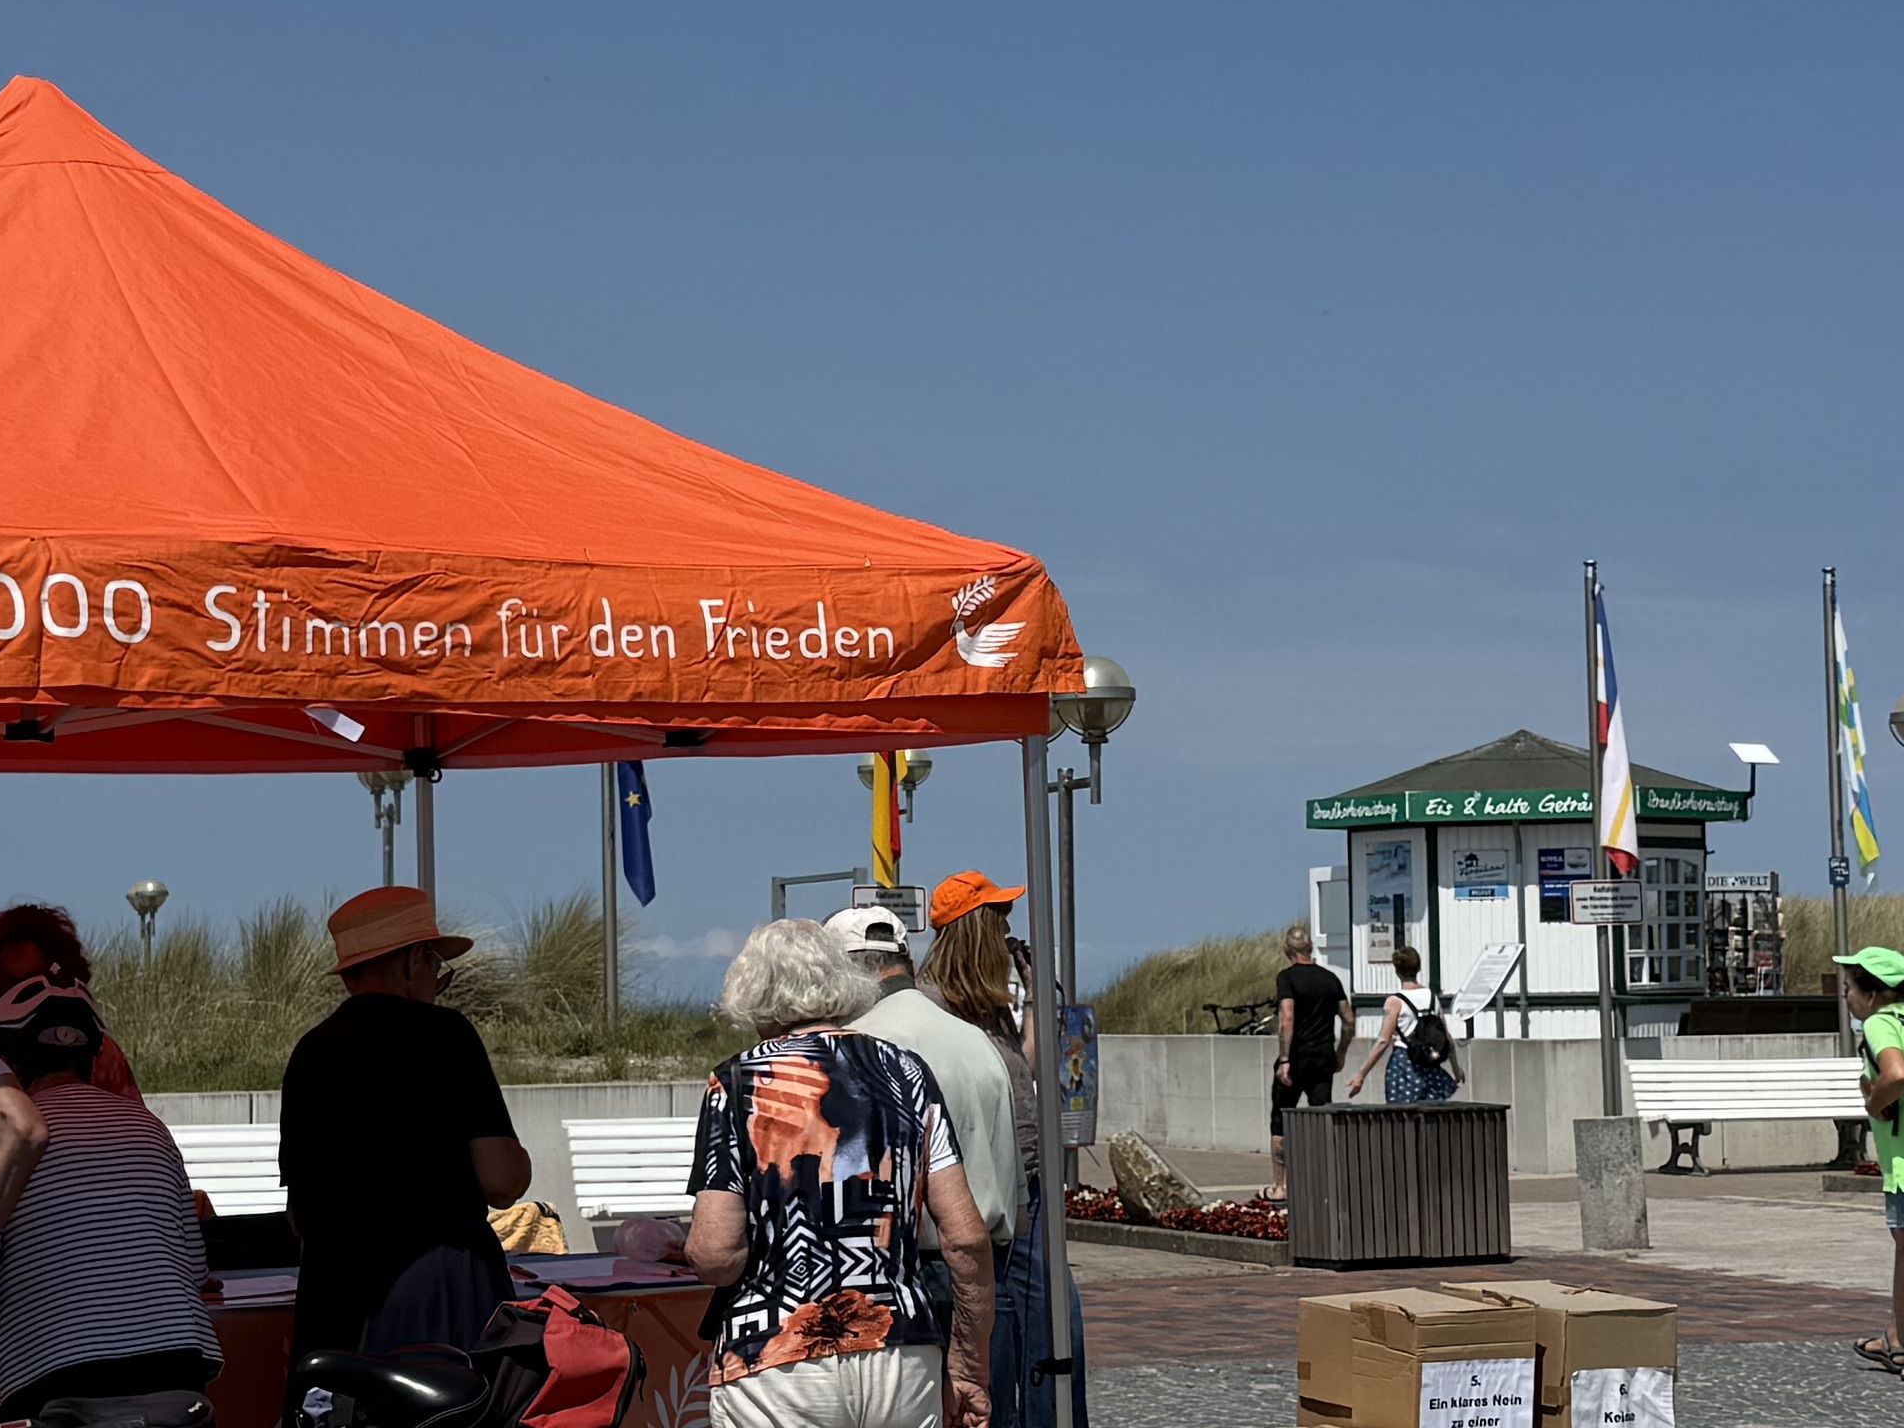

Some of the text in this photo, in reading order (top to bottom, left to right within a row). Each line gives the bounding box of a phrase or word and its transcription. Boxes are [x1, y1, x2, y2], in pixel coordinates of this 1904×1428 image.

[203, 585, 472, 660] Stimmen
[496, 597, 568, 660] für
[590, 597, 676, 659] den
[698, 598, 895, 661] Frieden
[1425, 792, 1593, 816] Eis & kalte Geträ
[1707, 876, 1769, 887] DIE WELT
[1470, 1375, 1481, 1387] 5.
[1429, 1398, 1448, 1410] Ein
